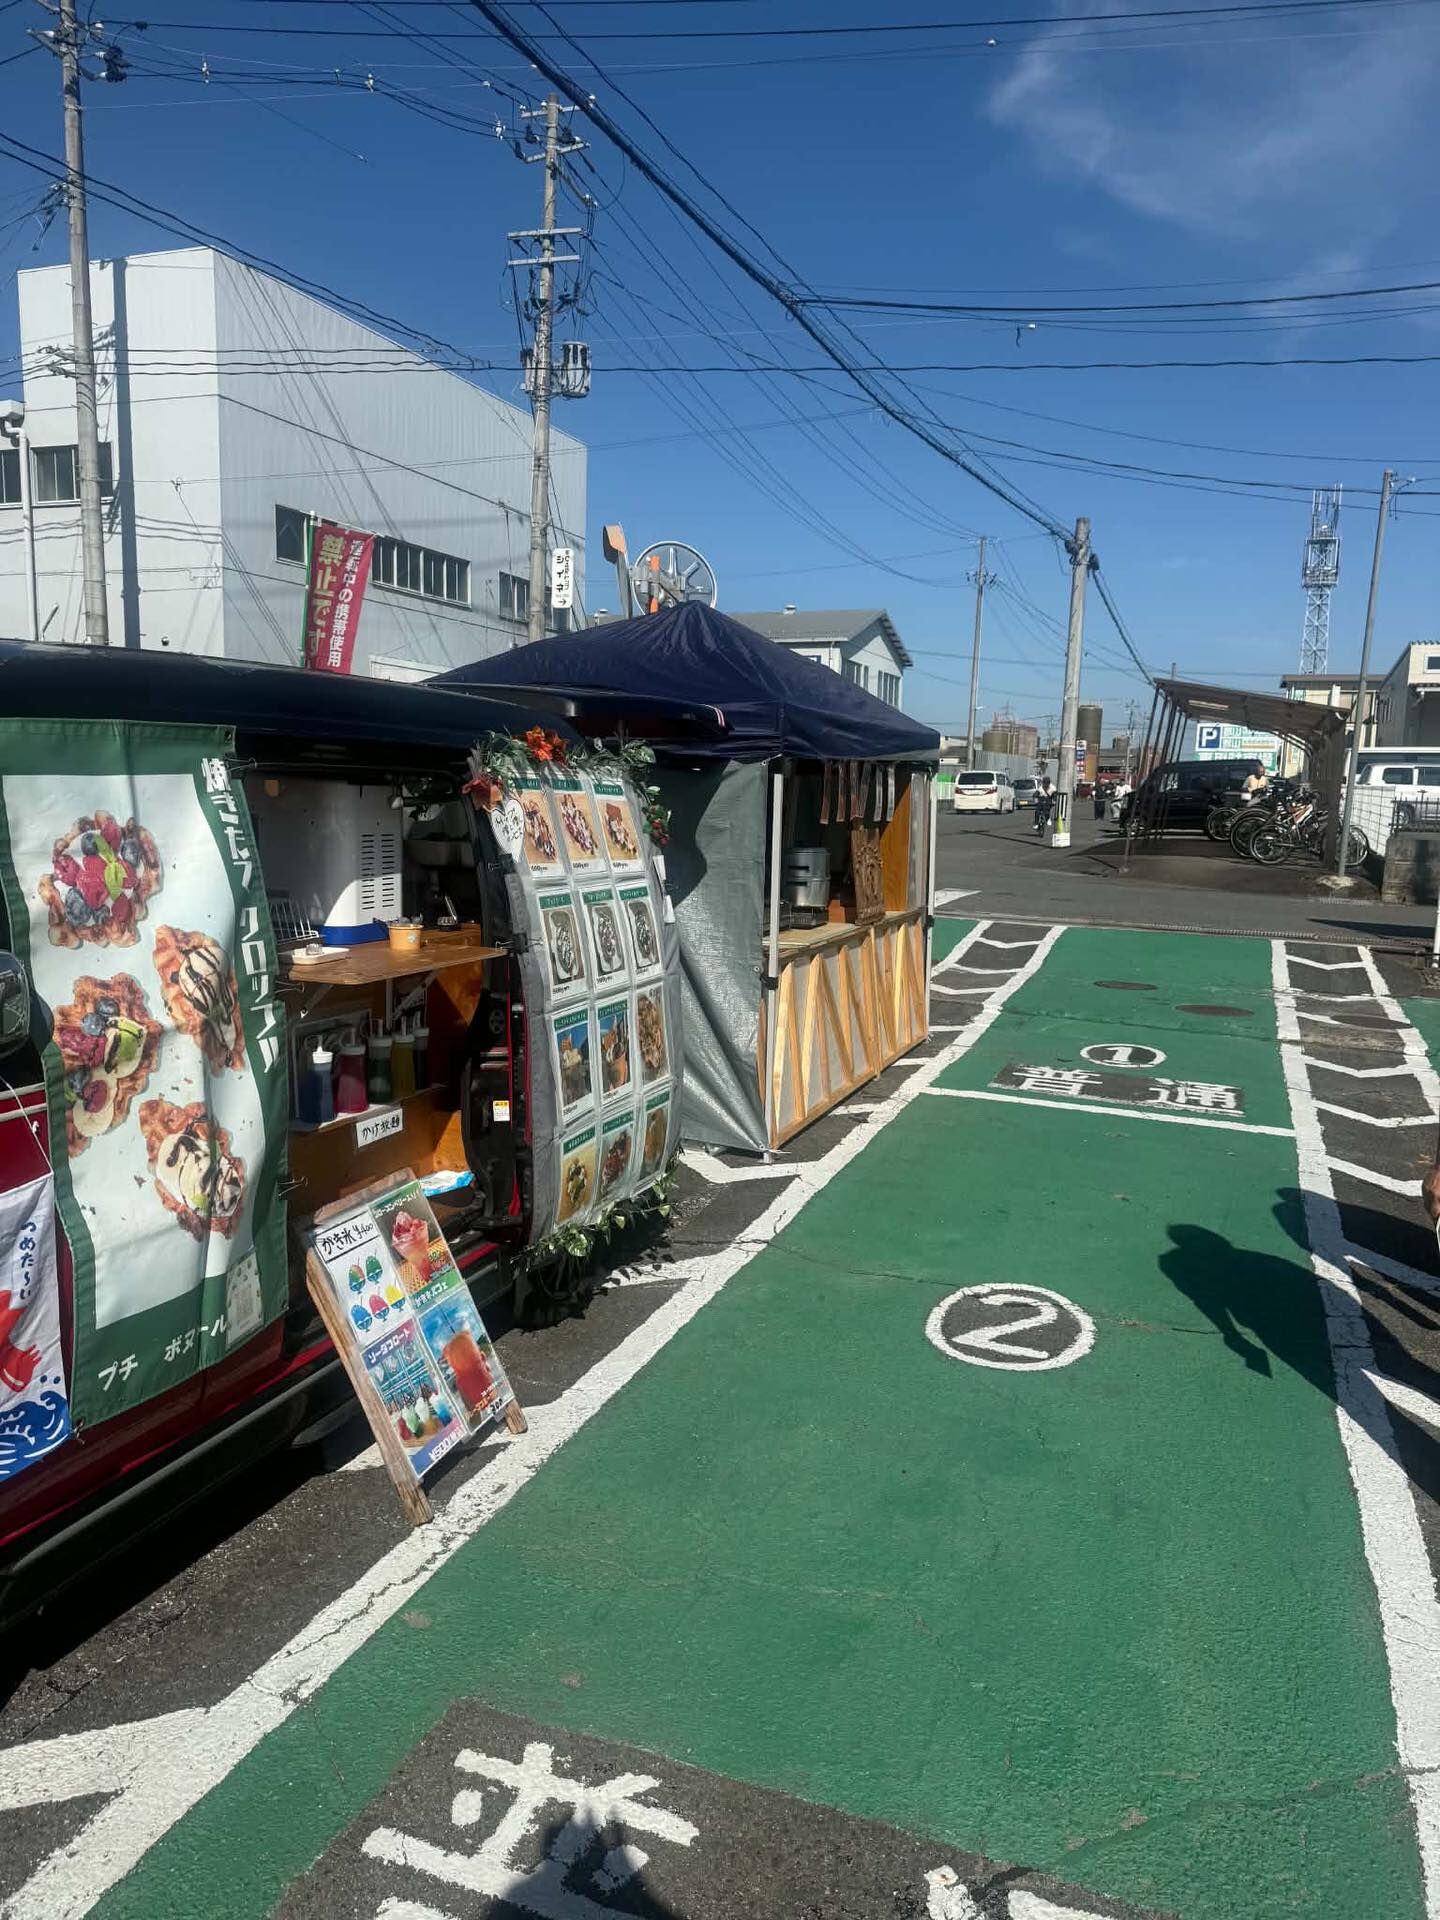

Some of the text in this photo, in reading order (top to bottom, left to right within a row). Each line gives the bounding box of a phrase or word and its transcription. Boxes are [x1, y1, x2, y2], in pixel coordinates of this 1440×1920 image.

[1202, 727, 1218, 748] P
[1012, 1064, 1246, 1115] 普通
[98, 1353, 139, 1392] プチ
